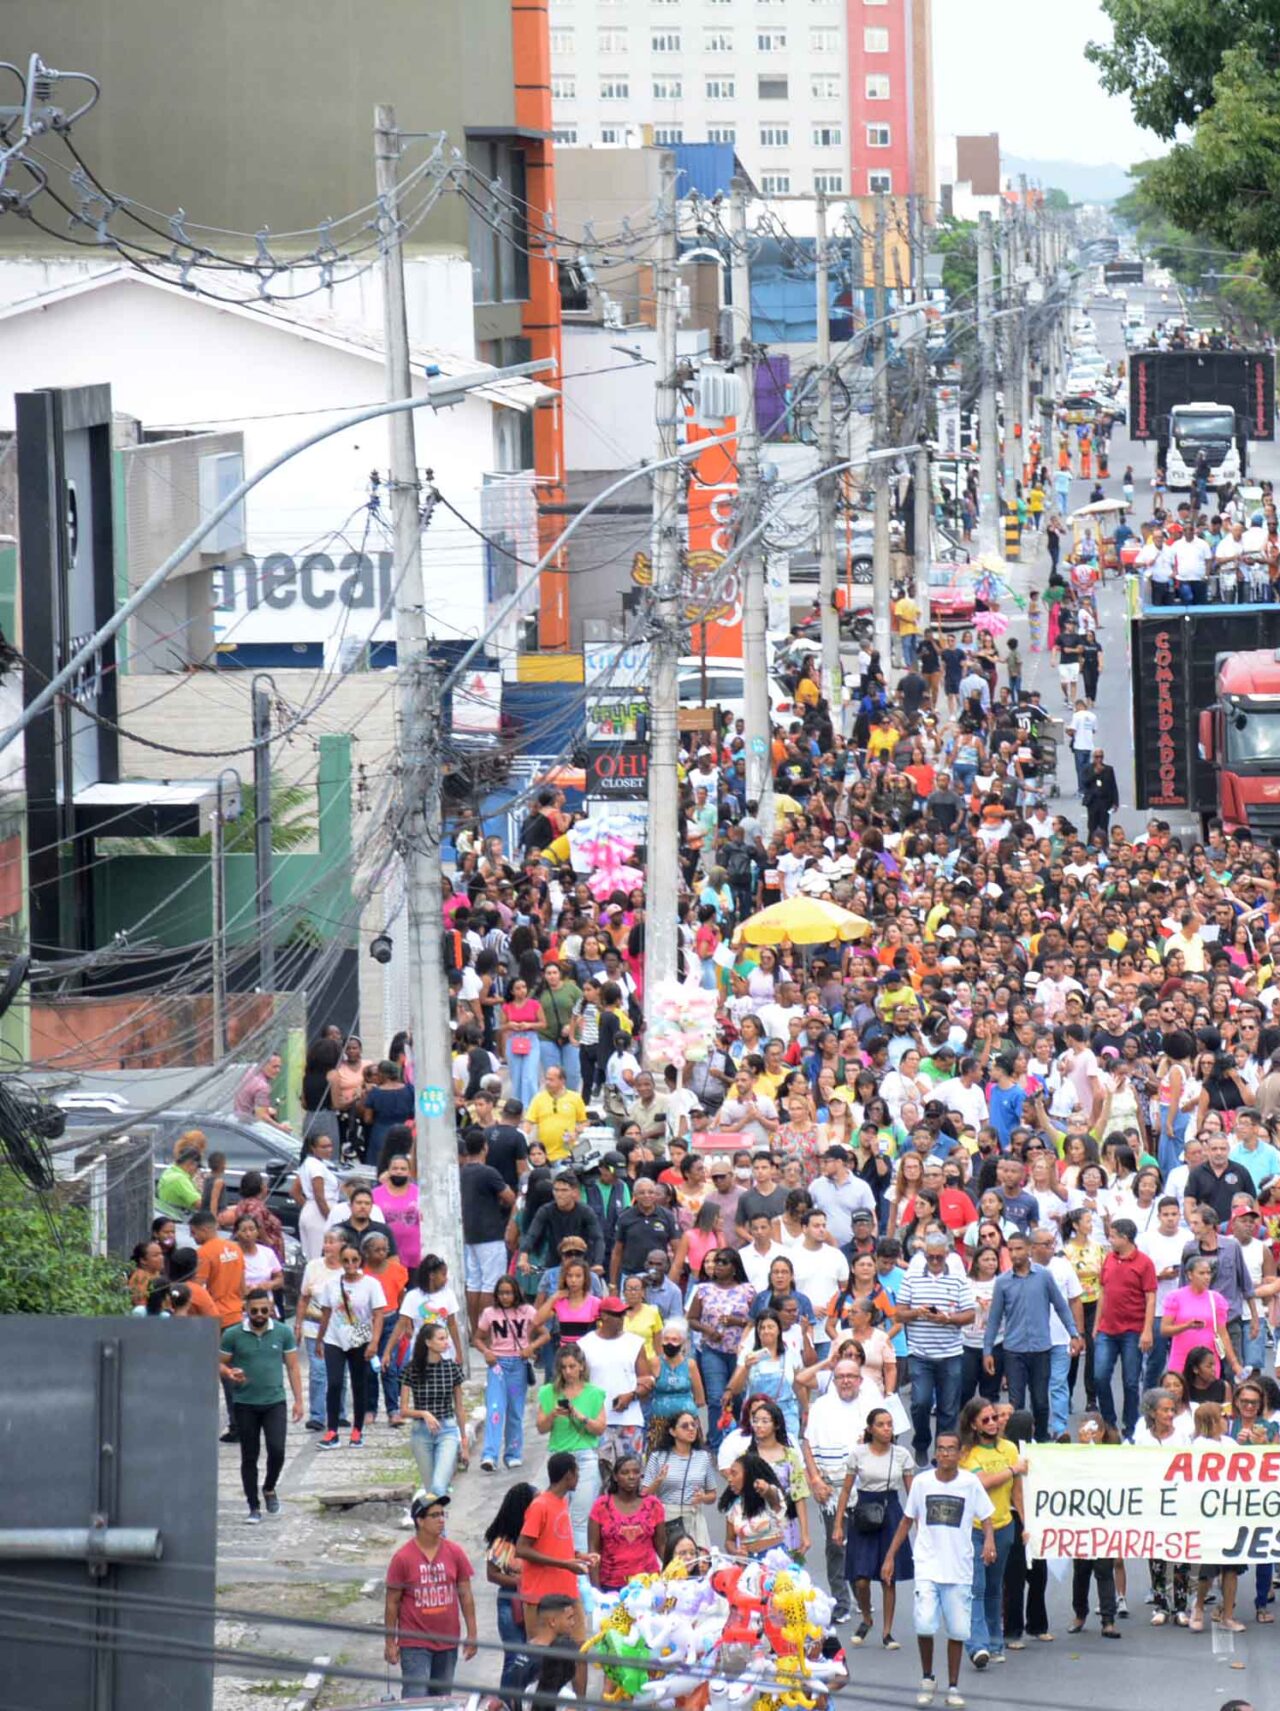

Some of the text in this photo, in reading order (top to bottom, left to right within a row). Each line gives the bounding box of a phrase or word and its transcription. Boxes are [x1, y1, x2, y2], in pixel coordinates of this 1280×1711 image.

[1154, 631, 1176, 797] COMENDADOR
[594, 754, 648, 777] OH!
[601, 777, 645, 788] CLOSET
[492, 1318, 526, 1339] NY
[1035, 1487, 1143, 1519] PORQUE
[1160, 1482, 1179, 1516] É
[1040, 1527, 1202, 1560] PREPARA-SE
